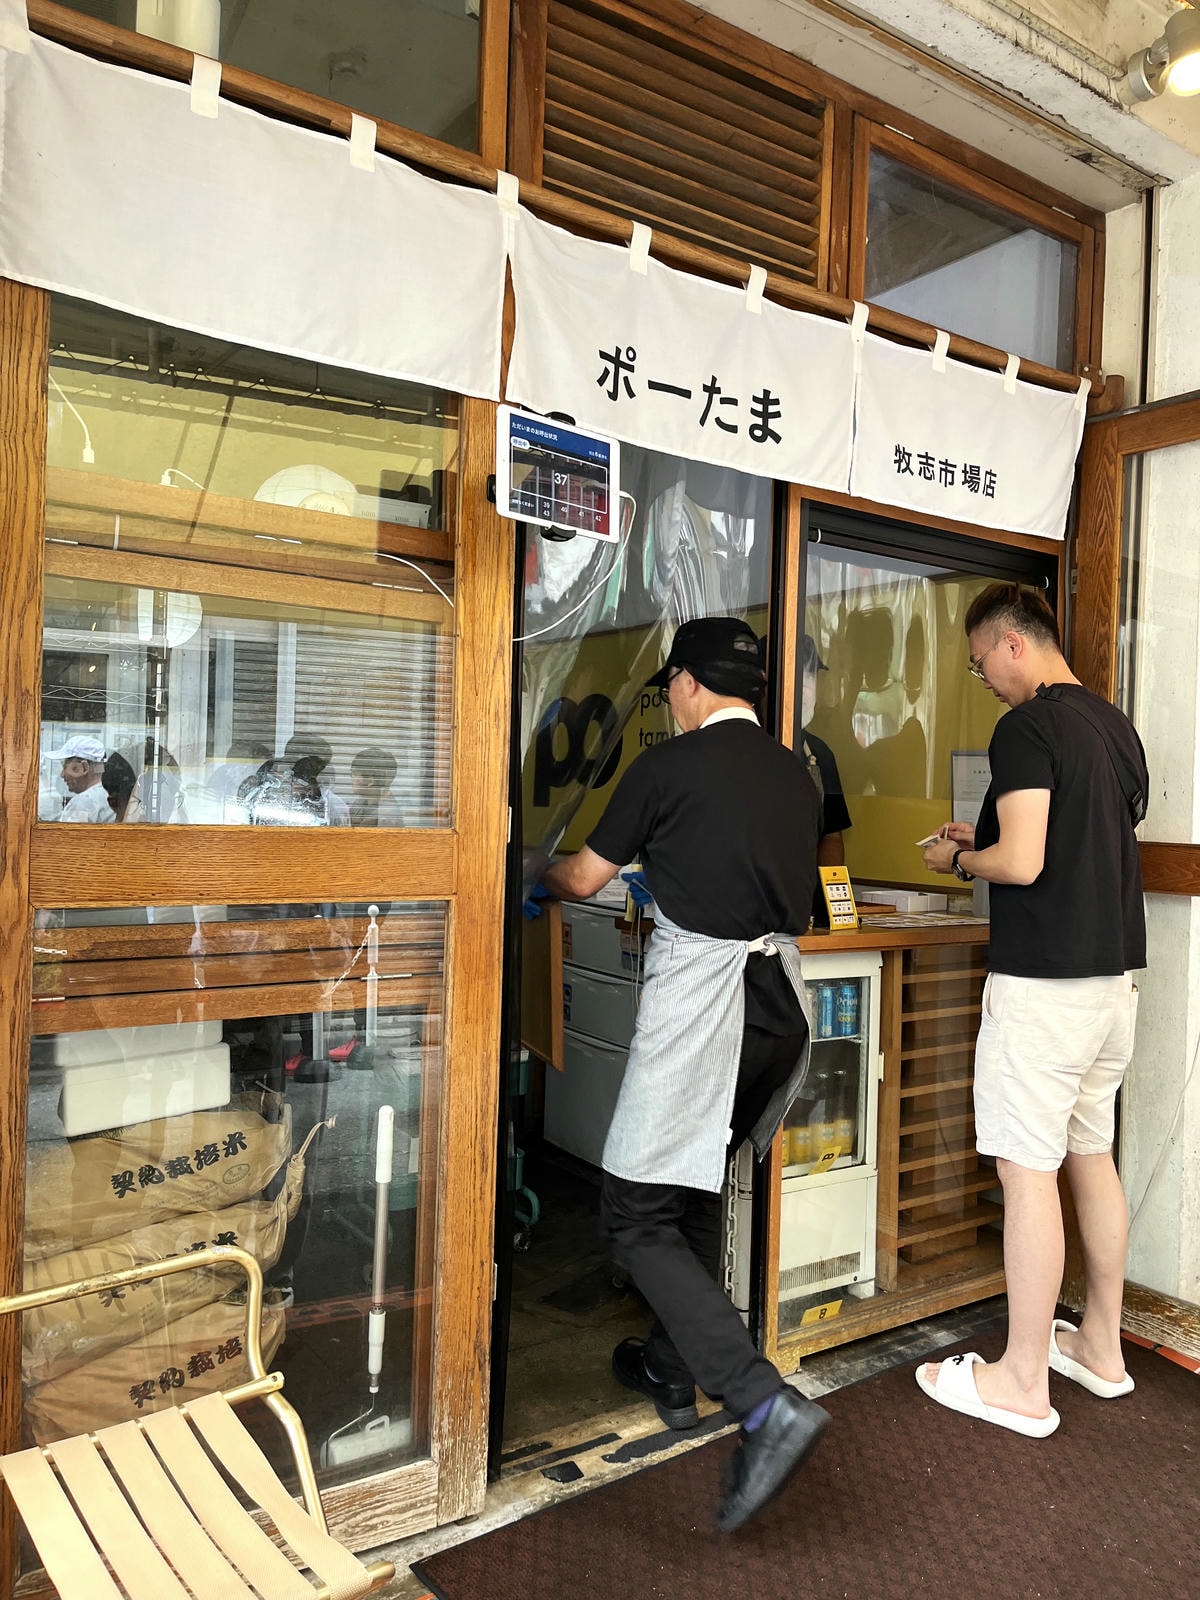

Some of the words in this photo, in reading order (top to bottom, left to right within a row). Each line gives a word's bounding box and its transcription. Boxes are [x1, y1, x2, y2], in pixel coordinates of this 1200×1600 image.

[596, 346, 783, 445] ポーたま
[554, 472, 568, 486] 37
[893, 443, 998, 499] 牧志市場店
[128, 1336, 245, 1408] 契約栽培
